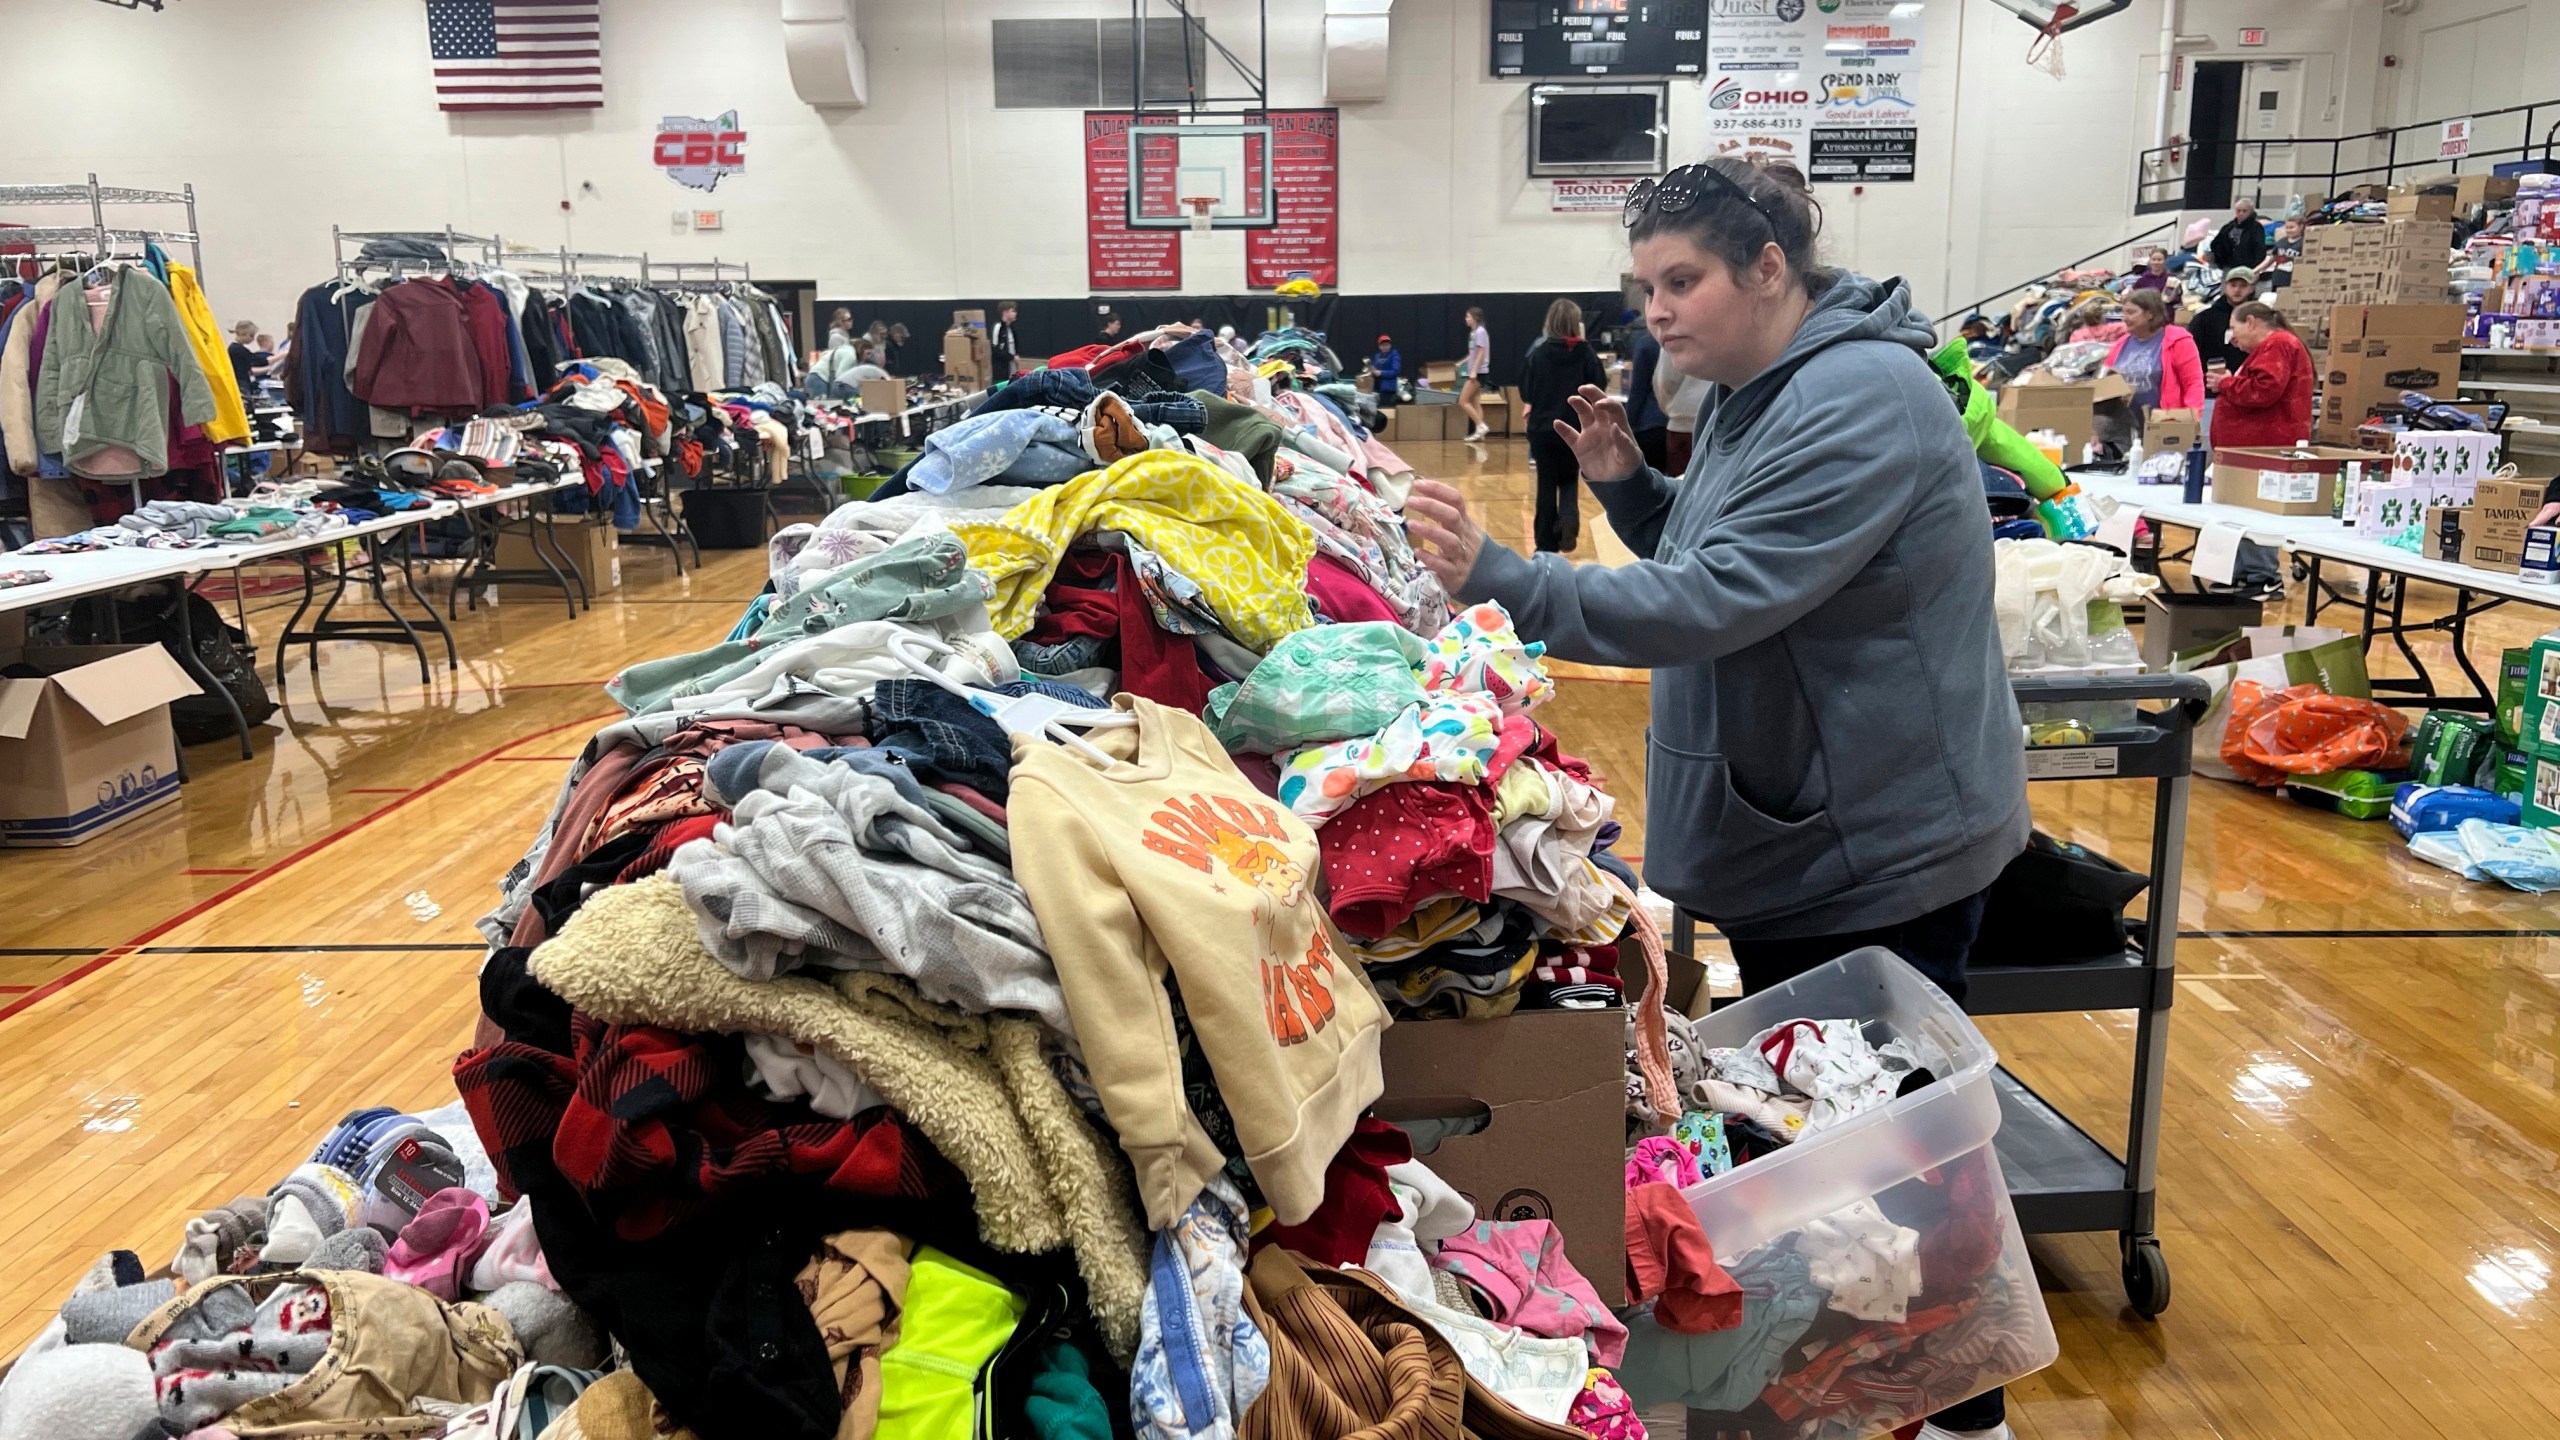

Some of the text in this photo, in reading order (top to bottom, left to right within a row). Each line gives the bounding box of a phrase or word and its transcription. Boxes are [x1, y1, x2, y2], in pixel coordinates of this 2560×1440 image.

[1711, 0, 1770, 18] Quest
[1606, 32, 1627, 41] FOUL
[1675, 31, 1701, 41] FOULS
[1827, 24, 1890, 39] innovation
[1498, 33, 1523, 42] FOULS
[1841, 58, 1875, 67] integrity
[1816, 73, 1901, 104] SPEND A DAY
[1745, 91, 1809, 104] OHIO
[1825, 110, 1852, 119] Good
[1853, 110, 1873, 119] Luck
[1298, 117, 1336, 139] LAKE
[1714, 119, 1802, 129] 937-686-4313
[2448, 122, 2465, 139] HOME
[653, 131, 747, 166] CBC
[1295, 148, 1327, 157] SONG
[1821, 142, 1871, 152] ATTORNEYS
[1885, 142, 1906, 151] LAW
[2440, 139, 2468, 157] STUDENTS
[1558, 185, 1628, 195] HONDA
[2388, 375, 2436, 385] Our Family
[1141, 793, 1290, 875] HOWDY
[404, 1143, 416, 1157] 10
